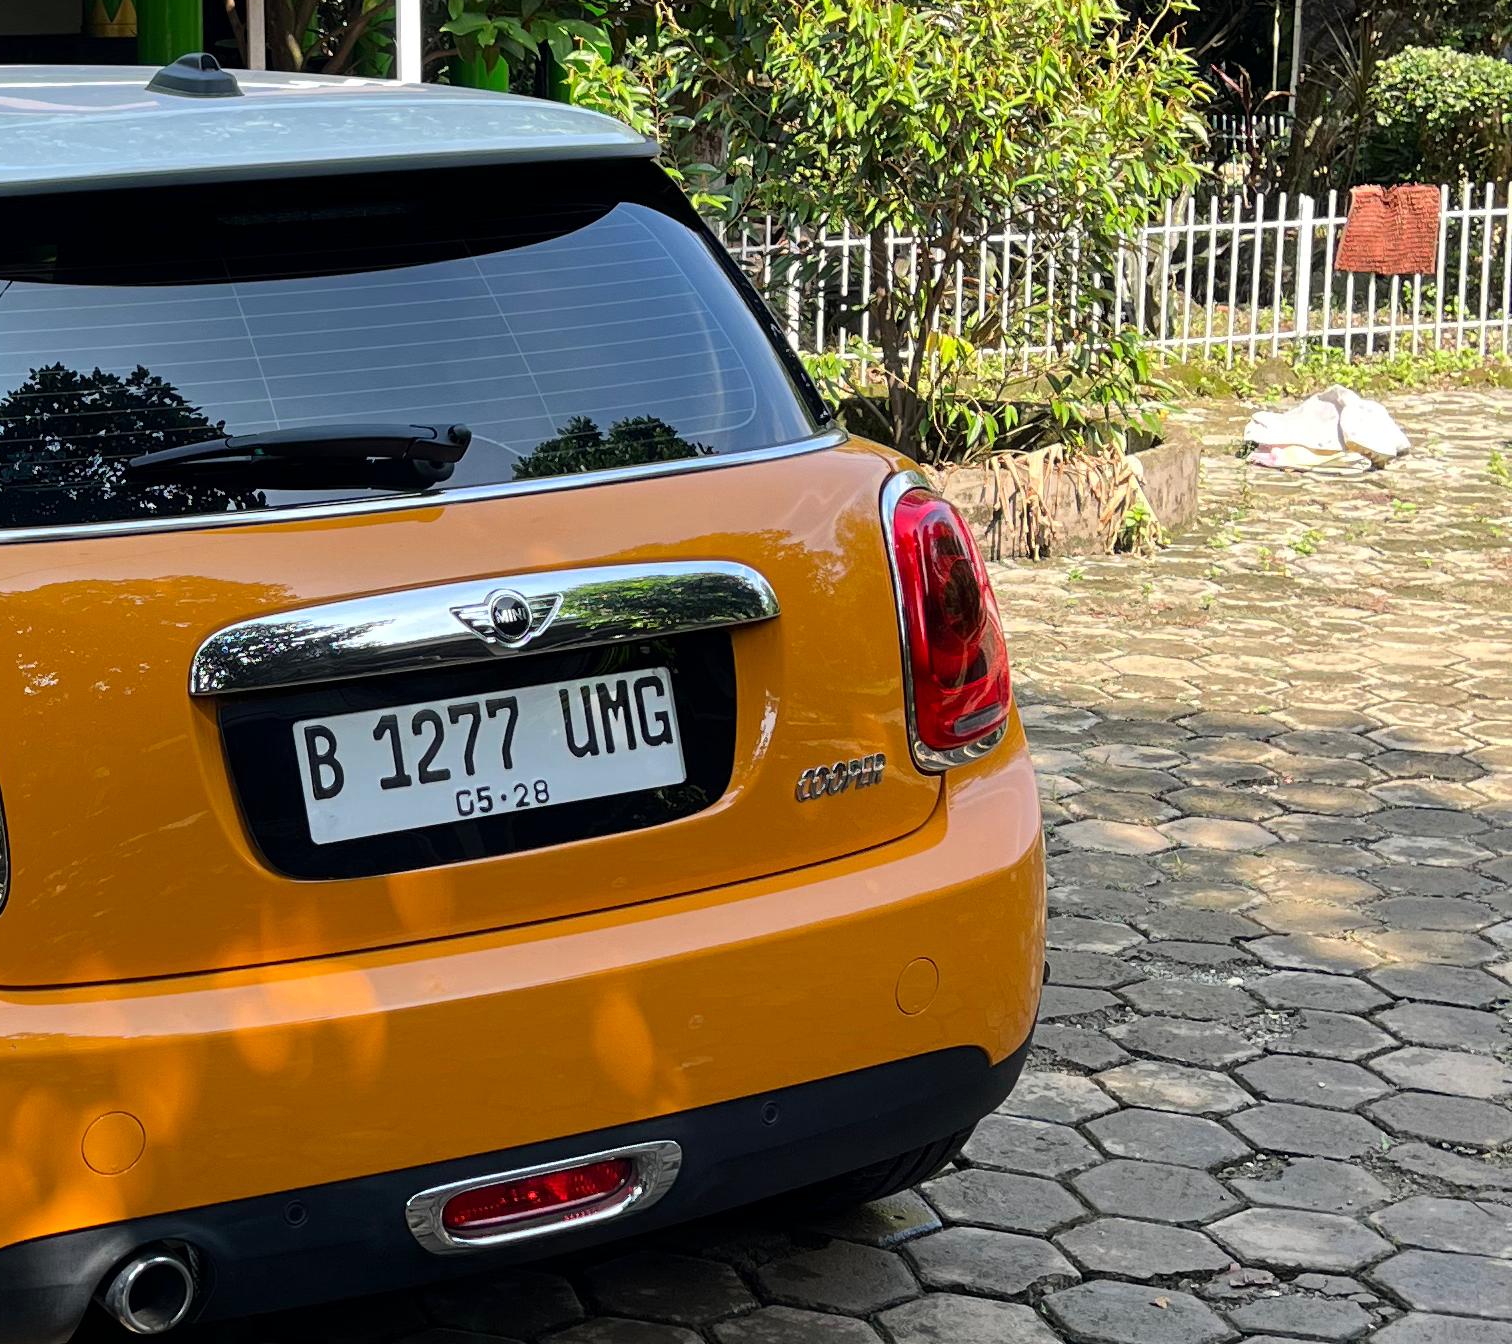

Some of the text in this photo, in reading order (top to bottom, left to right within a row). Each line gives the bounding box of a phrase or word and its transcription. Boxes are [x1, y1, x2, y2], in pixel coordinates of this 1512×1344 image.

[494, 607, 528, 624] MINI
[303, 675, 674, 801] B 1277 UMG
[795, 752, 886, 802] COOPER
